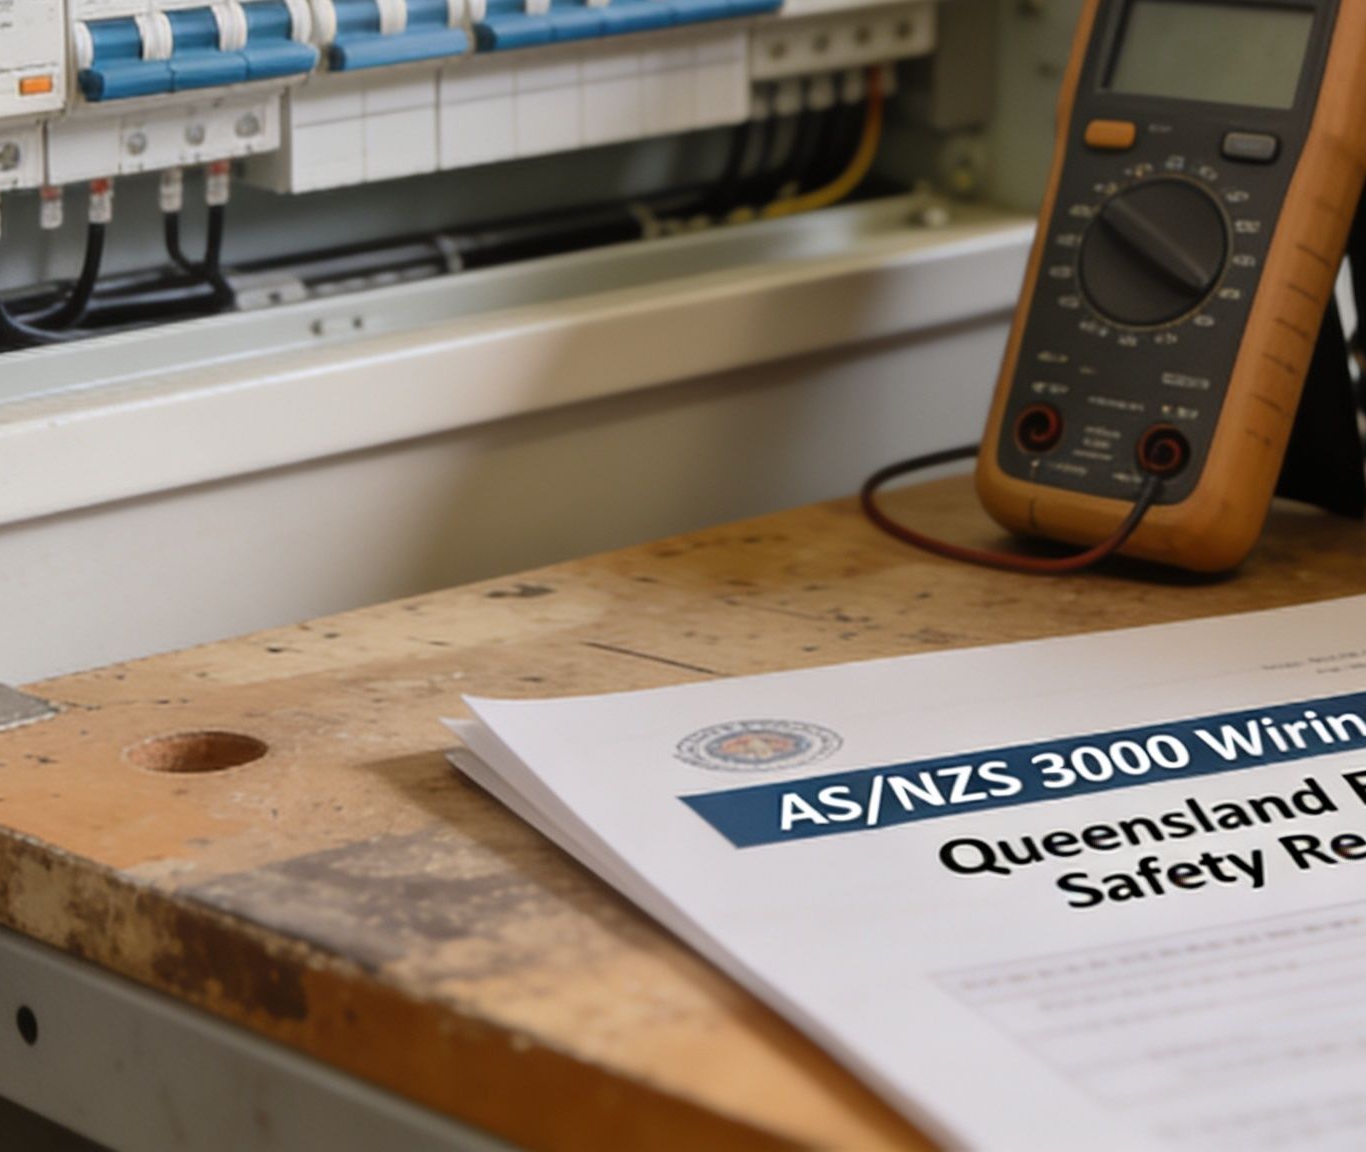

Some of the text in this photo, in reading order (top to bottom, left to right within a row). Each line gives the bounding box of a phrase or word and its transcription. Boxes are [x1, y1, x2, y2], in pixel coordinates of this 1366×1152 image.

[776, 757, 1024, 832] AS/NZS
[1032, 732, 1191, 791] 3000
[938, 776, 1338, 878] Queensland
[1056, 843, 1267, 910] Safety
